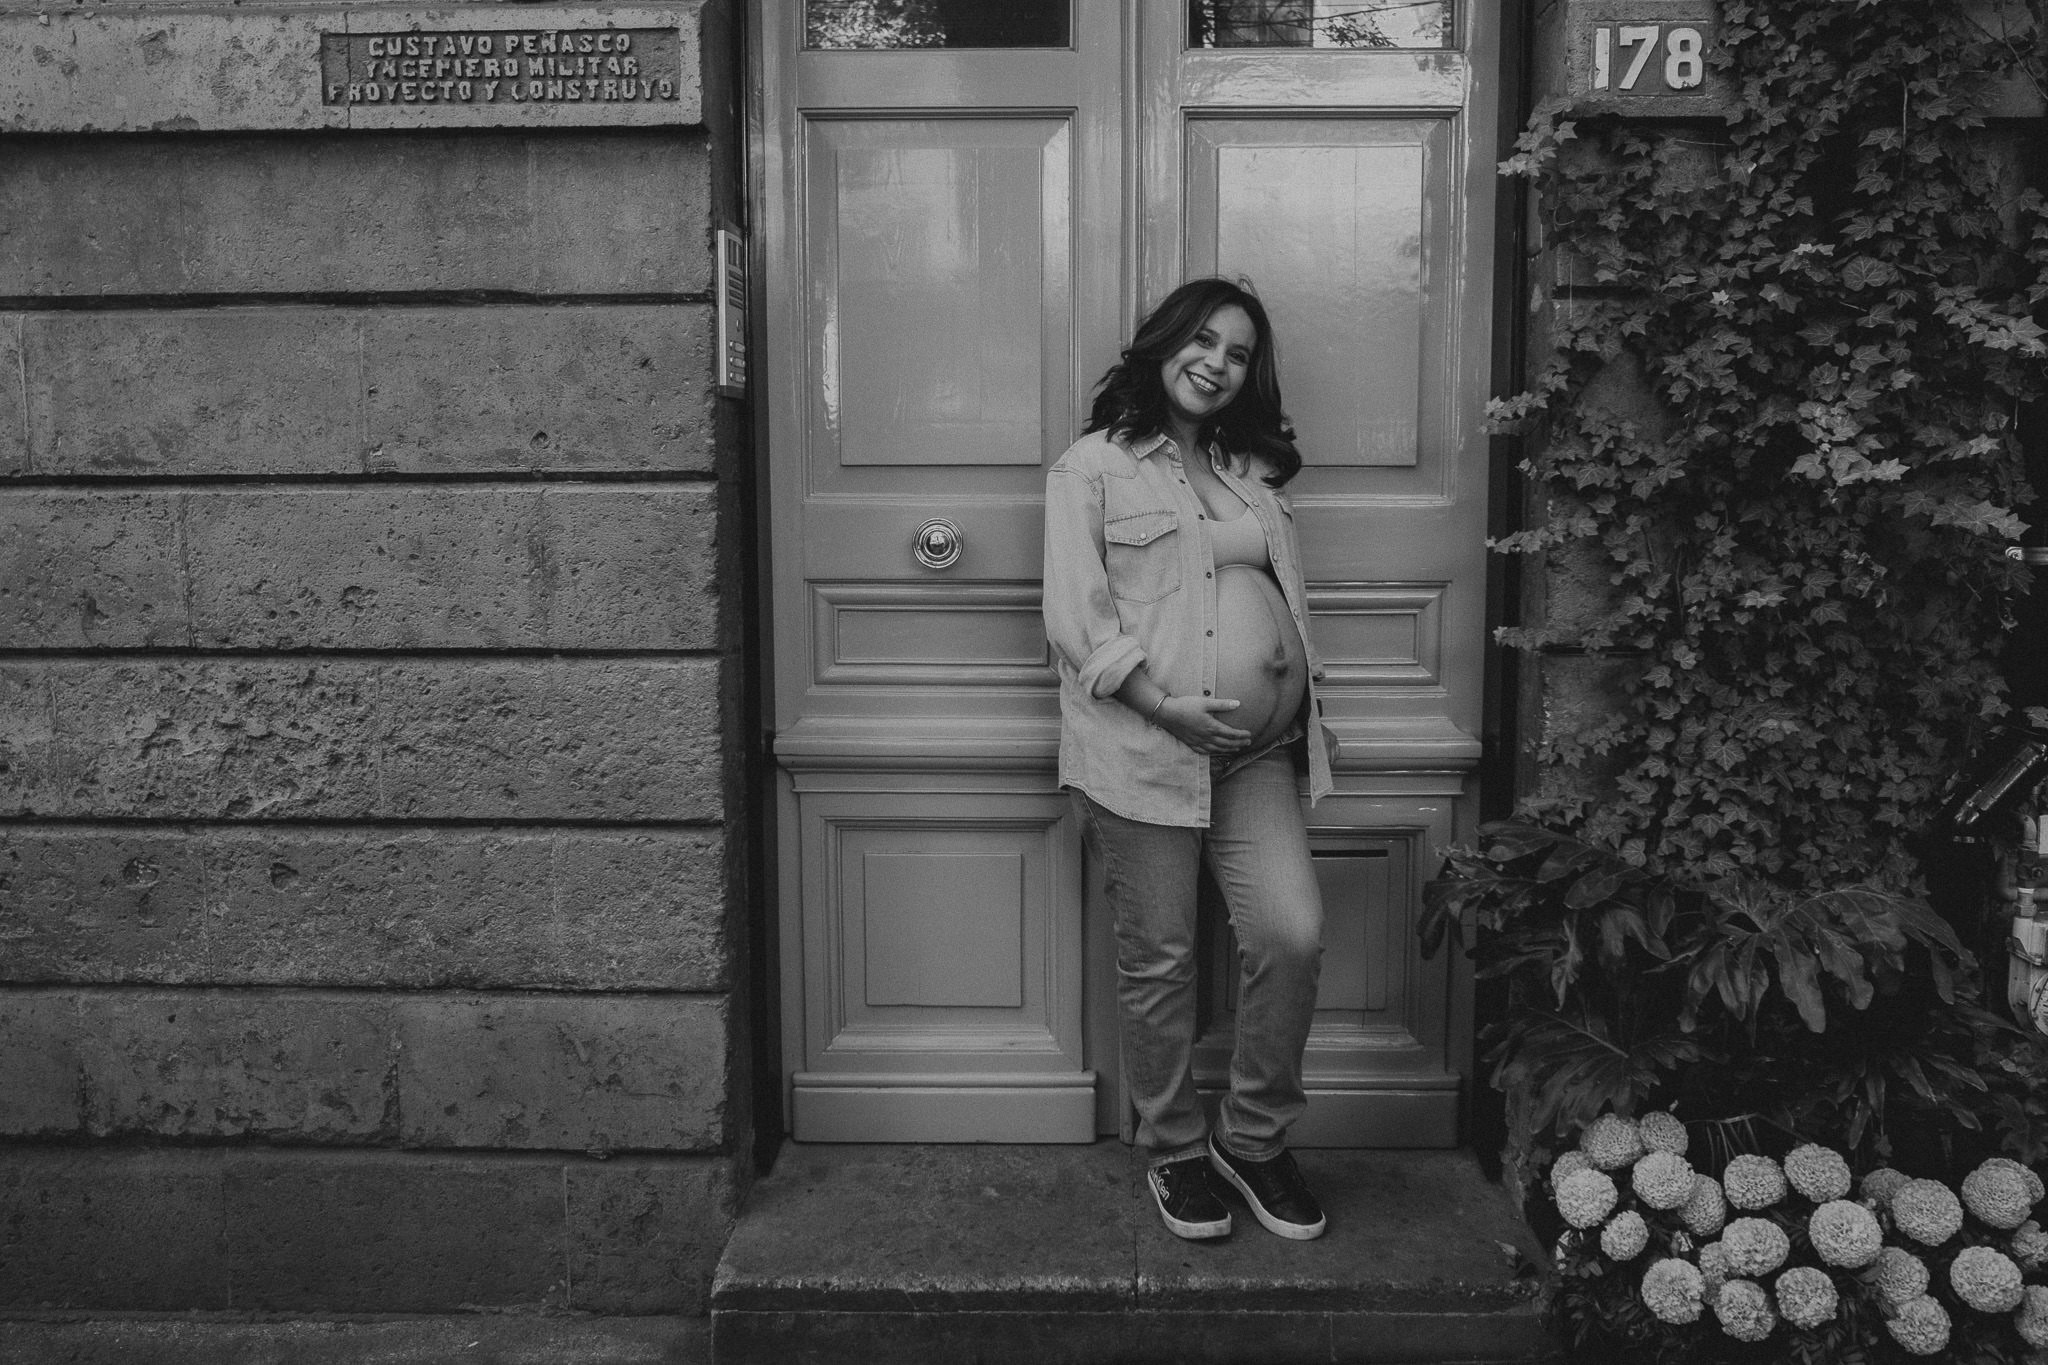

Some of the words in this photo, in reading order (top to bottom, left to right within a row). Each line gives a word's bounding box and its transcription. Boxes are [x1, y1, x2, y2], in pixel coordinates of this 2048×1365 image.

[368, 35, 492, 56] GUSTAVO
[528, 56, 639, 77] MILITAR
[1594, 25, 1703, 90] 178
[485, 80, 499, 101] Y
